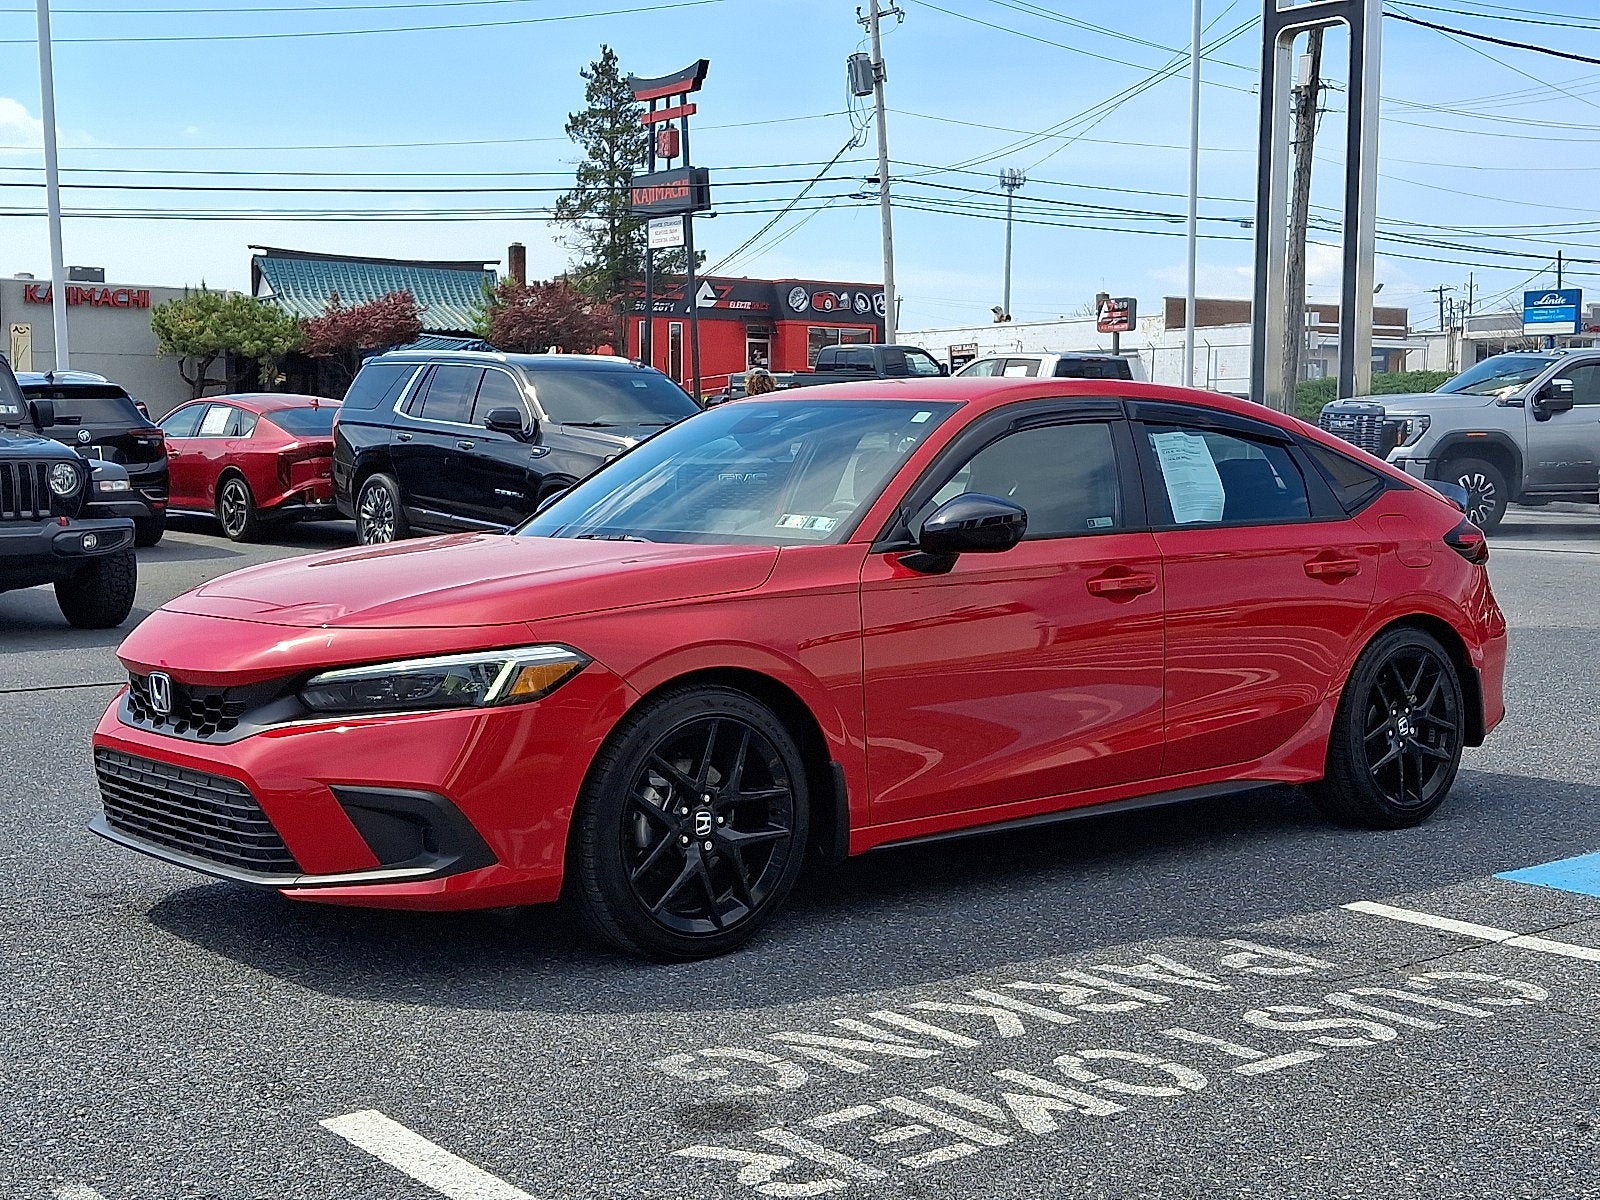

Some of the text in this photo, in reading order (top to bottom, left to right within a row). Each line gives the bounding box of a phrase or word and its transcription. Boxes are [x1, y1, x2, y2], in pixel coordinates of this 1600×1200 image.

[632, 179, 690, 205] KAJIMACHI
[24, 284, 151, 308] KAIMACHI
[1533, 293, 1567, 305] Linde
[717, 472, 769, 486] GMC
[650, 938, 1338, 1096] PARKING
[669, 970, 1550, 1198] CUSTOMER
